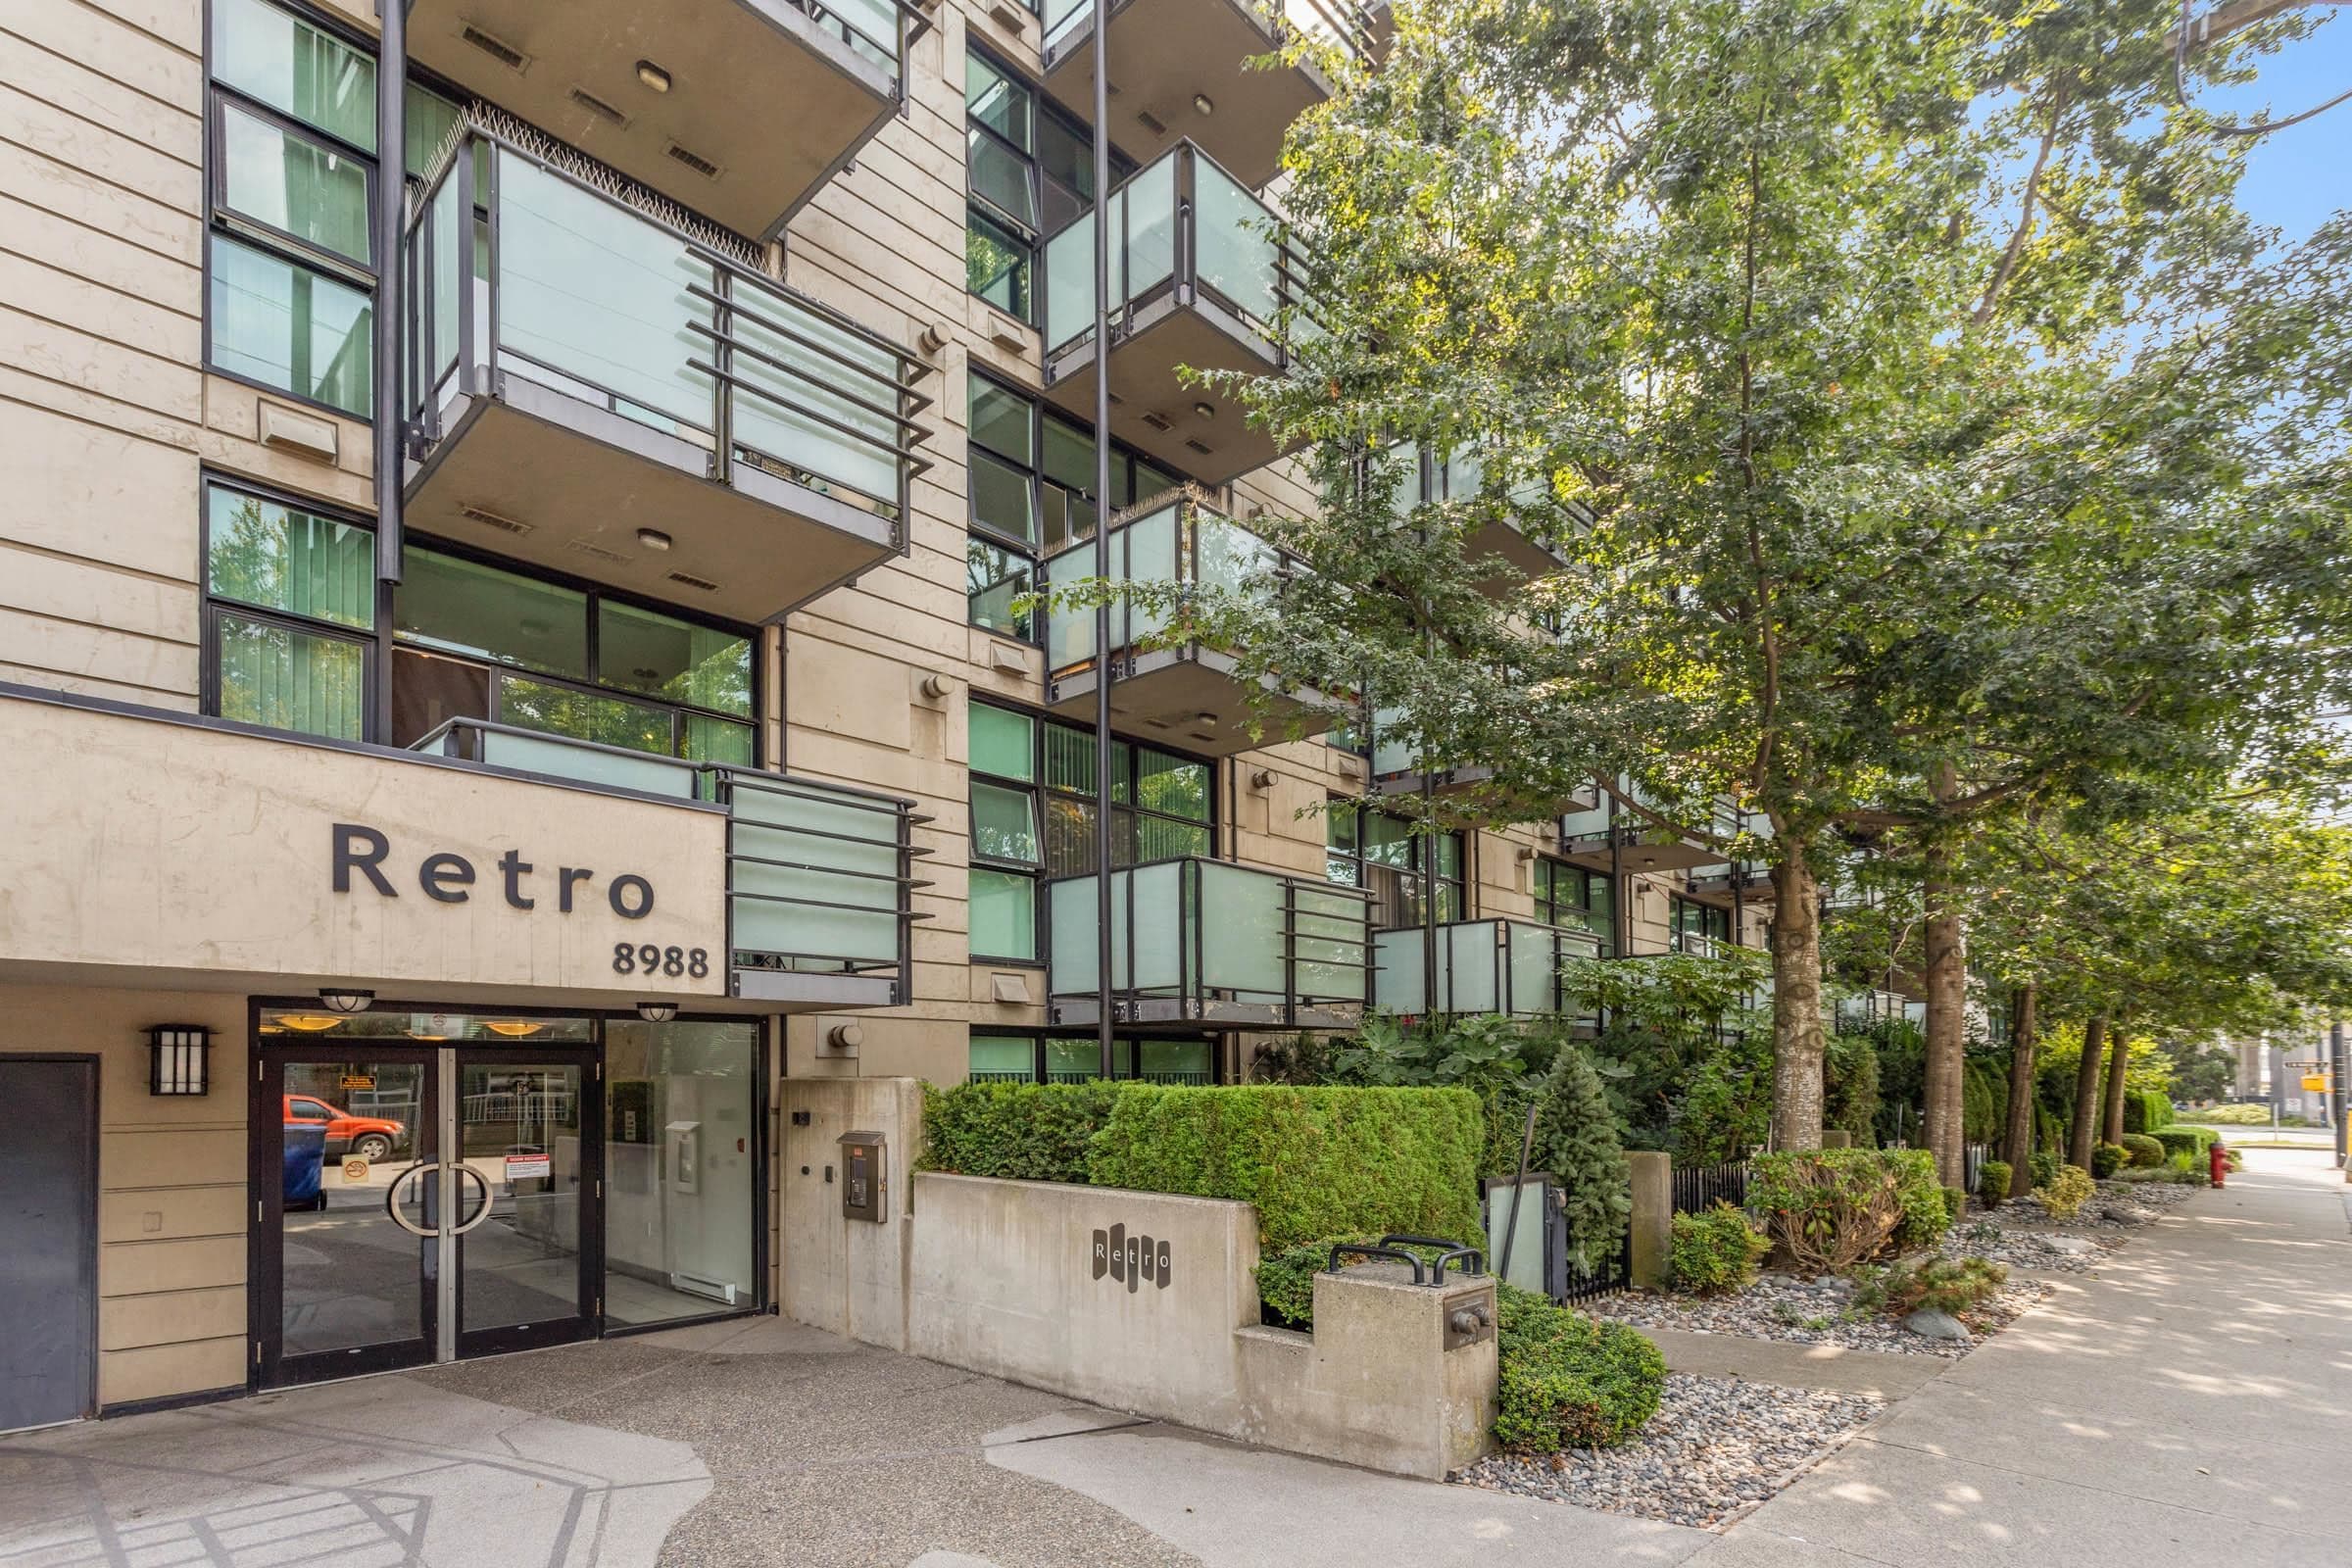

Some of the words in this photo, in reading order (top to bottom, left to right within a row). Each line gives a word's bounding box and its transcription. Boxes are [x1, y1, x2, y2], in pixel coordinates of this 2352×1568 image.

[332, 822, 655, 919] Retro
[612, 942, 709, 979] 8988
[1096, 1243, 1169, 1268] Retro
